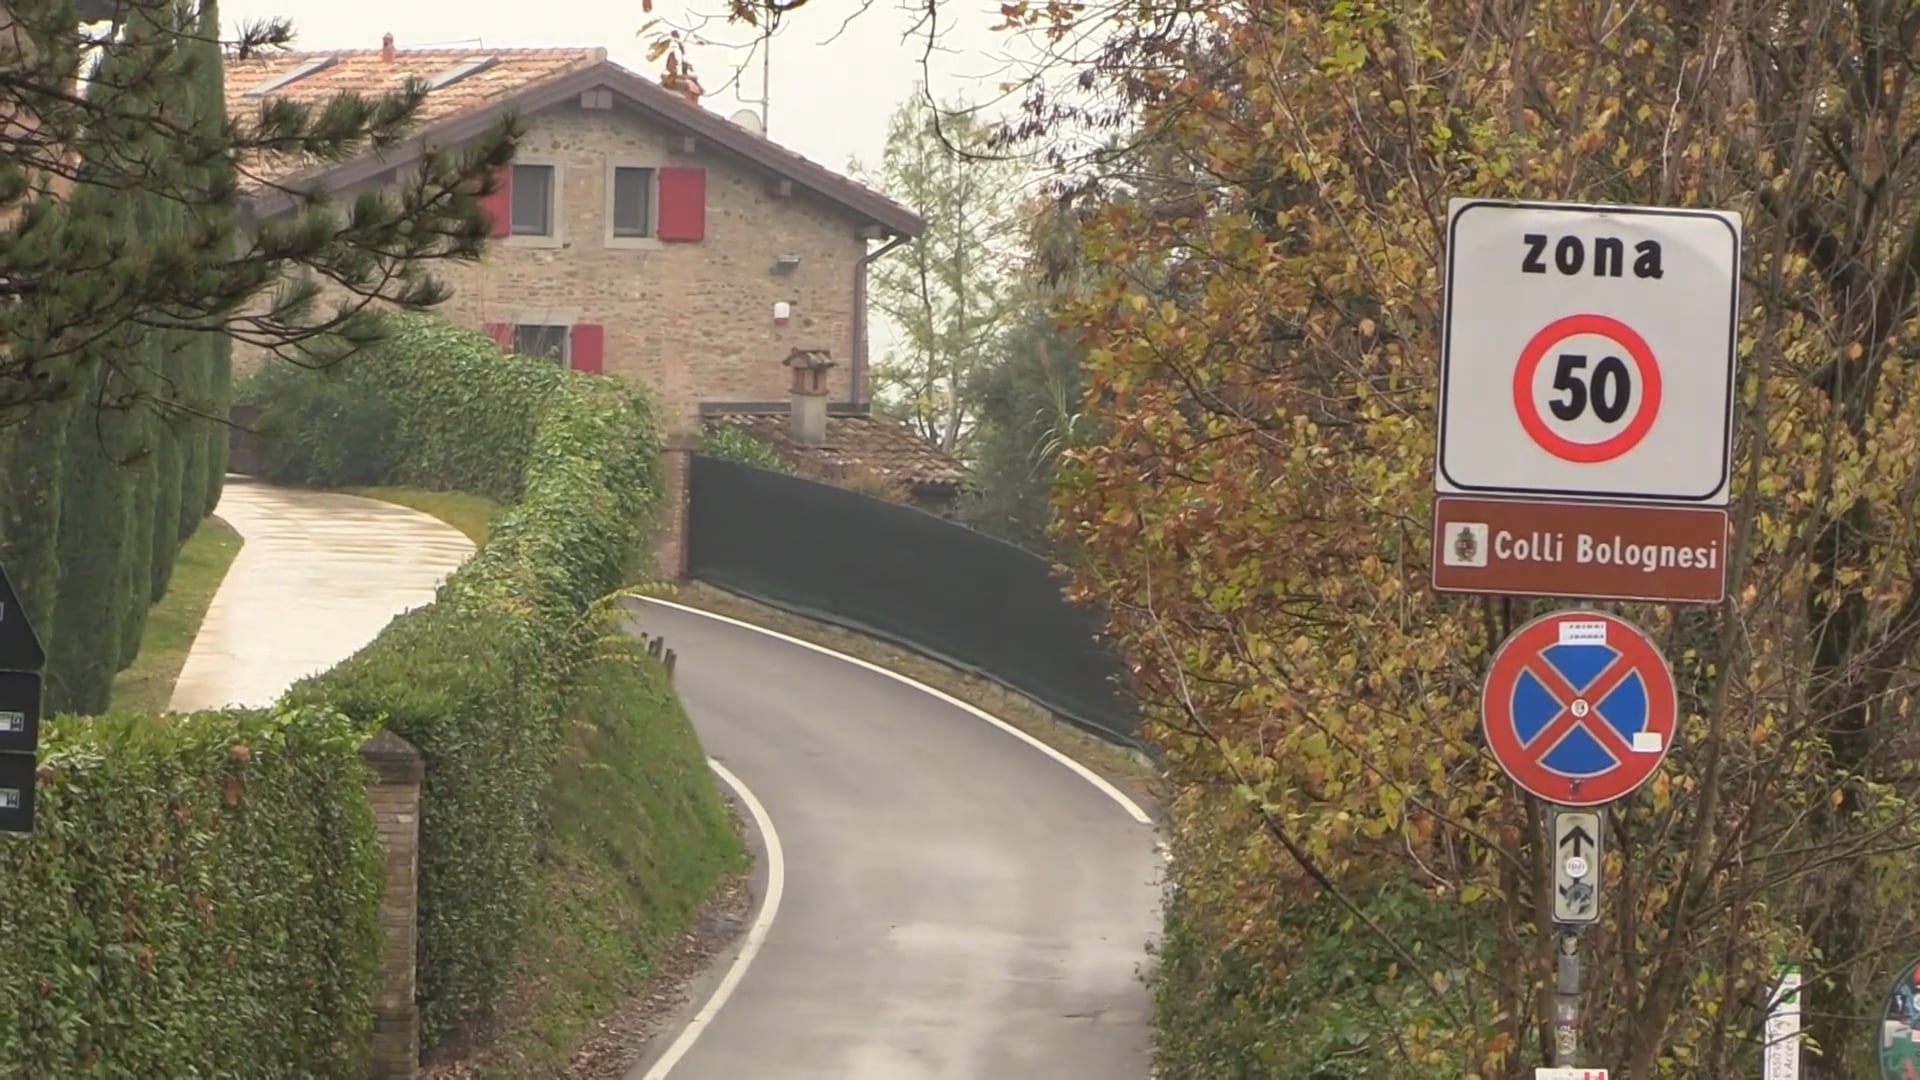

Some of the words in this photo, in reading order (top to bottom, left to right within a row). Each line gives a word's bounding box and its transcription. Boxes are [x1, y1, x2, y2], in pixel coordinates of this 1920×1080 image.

[1522, 233, 1664, 280] zona
[1548, 354, 1631, 424] 50
[1494, 530, 1563, 562] Colli
[1576, 534, 1717, 573] Bolognesi
